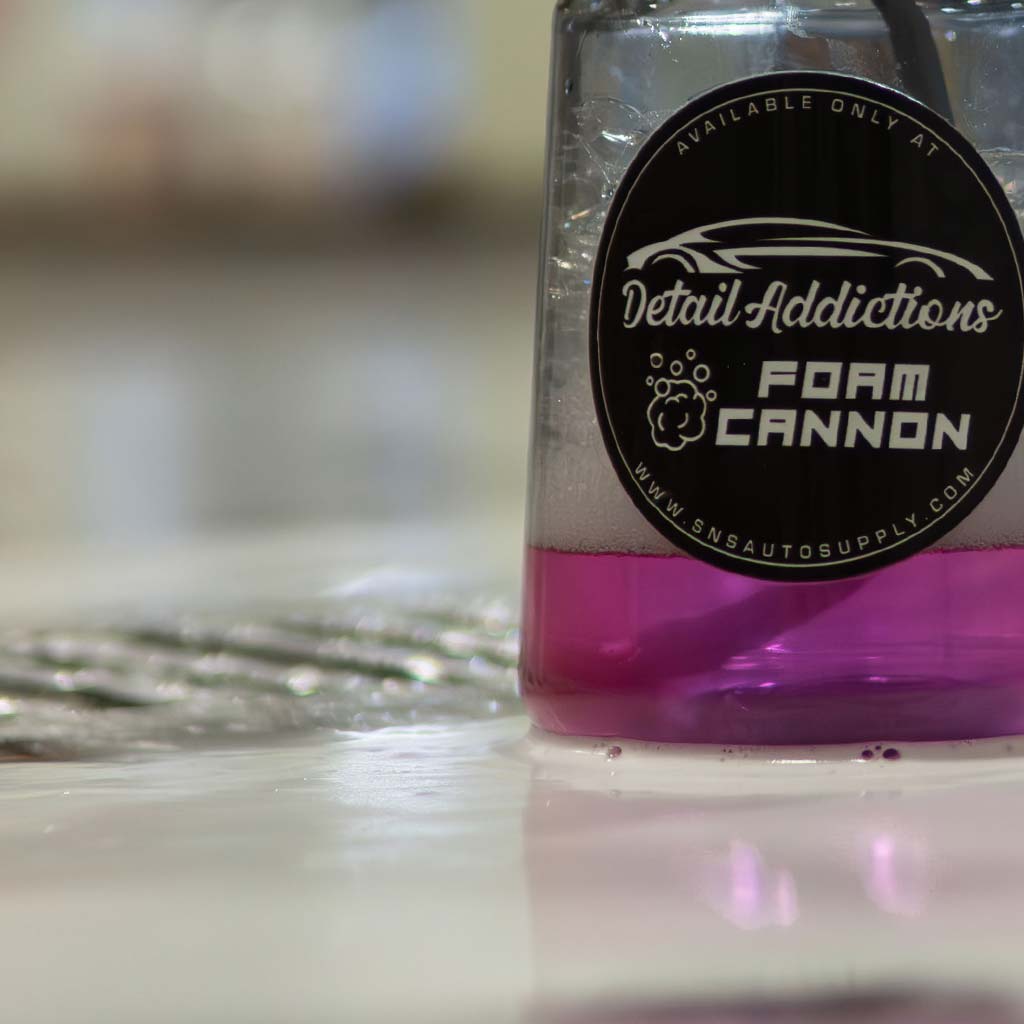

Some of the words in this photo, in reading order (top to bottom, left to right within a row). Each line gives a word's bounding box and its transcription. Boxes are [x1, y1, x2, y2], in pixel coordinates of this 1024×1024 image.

[676, 95, 812, 156] AVAILABLE
[831, 98, 899, 131] ONLY
[909, 133, 940, 157] AT
[621, 278, 742, 329] Detail
[744, 280, 1004, 334] Addictions
[757, 360, 931, 402] FOAM
[715, 407, 972, 451] CANNON
[634, 461, 975, 560] WWW.SNSAUTOSUPPLY.COM
